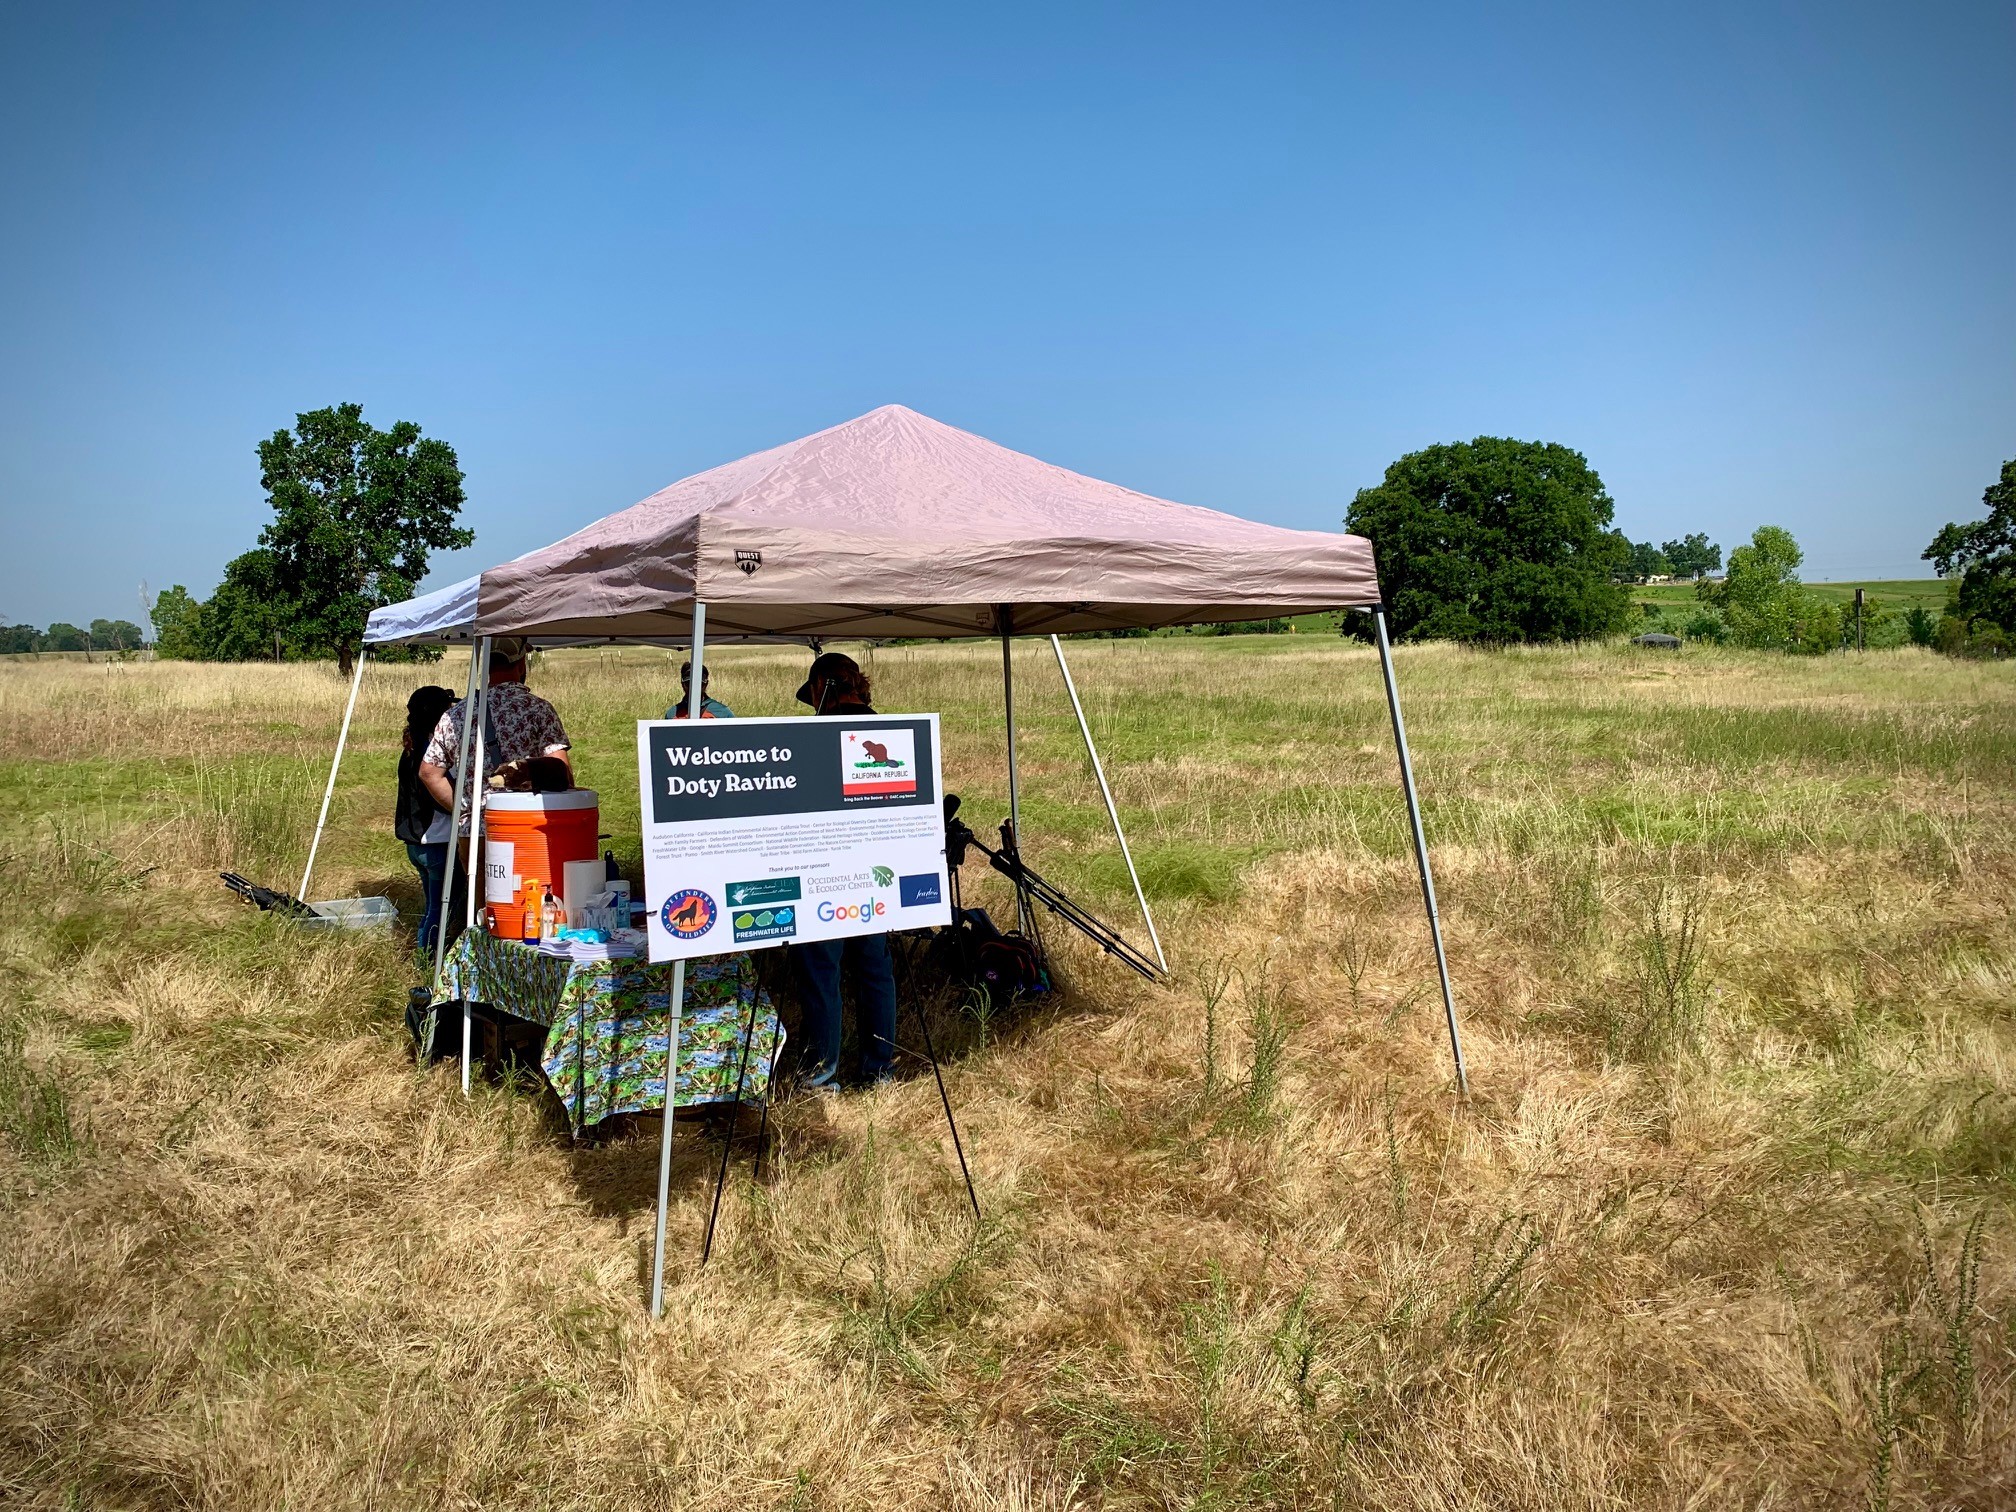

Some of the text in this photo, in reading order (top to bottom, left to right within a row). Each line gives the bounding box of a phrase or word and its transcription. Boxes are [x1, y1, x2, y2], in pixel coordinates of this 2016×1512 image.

[737, 551, 760, 560] QUEST
[666, 746, 792, 767] Welcome to
[852, 770, 909, 780] CALIFORNIA REPUBLIC
[667, 771, 798, 798] Doty Ravine
[807, 872, 870, 886] OCCIDENTAL ARTS
[816, 884, 846, 893] ECOLOGY
[848, 881, 874, 890] CENTER
[664, 889, 713, 910] DEFENDERS
[817, 897, 886, 922] Google
[666, 919, 714, 939] OF WILDLIFE
[736, 928, 780, 939] FRESHWATER
